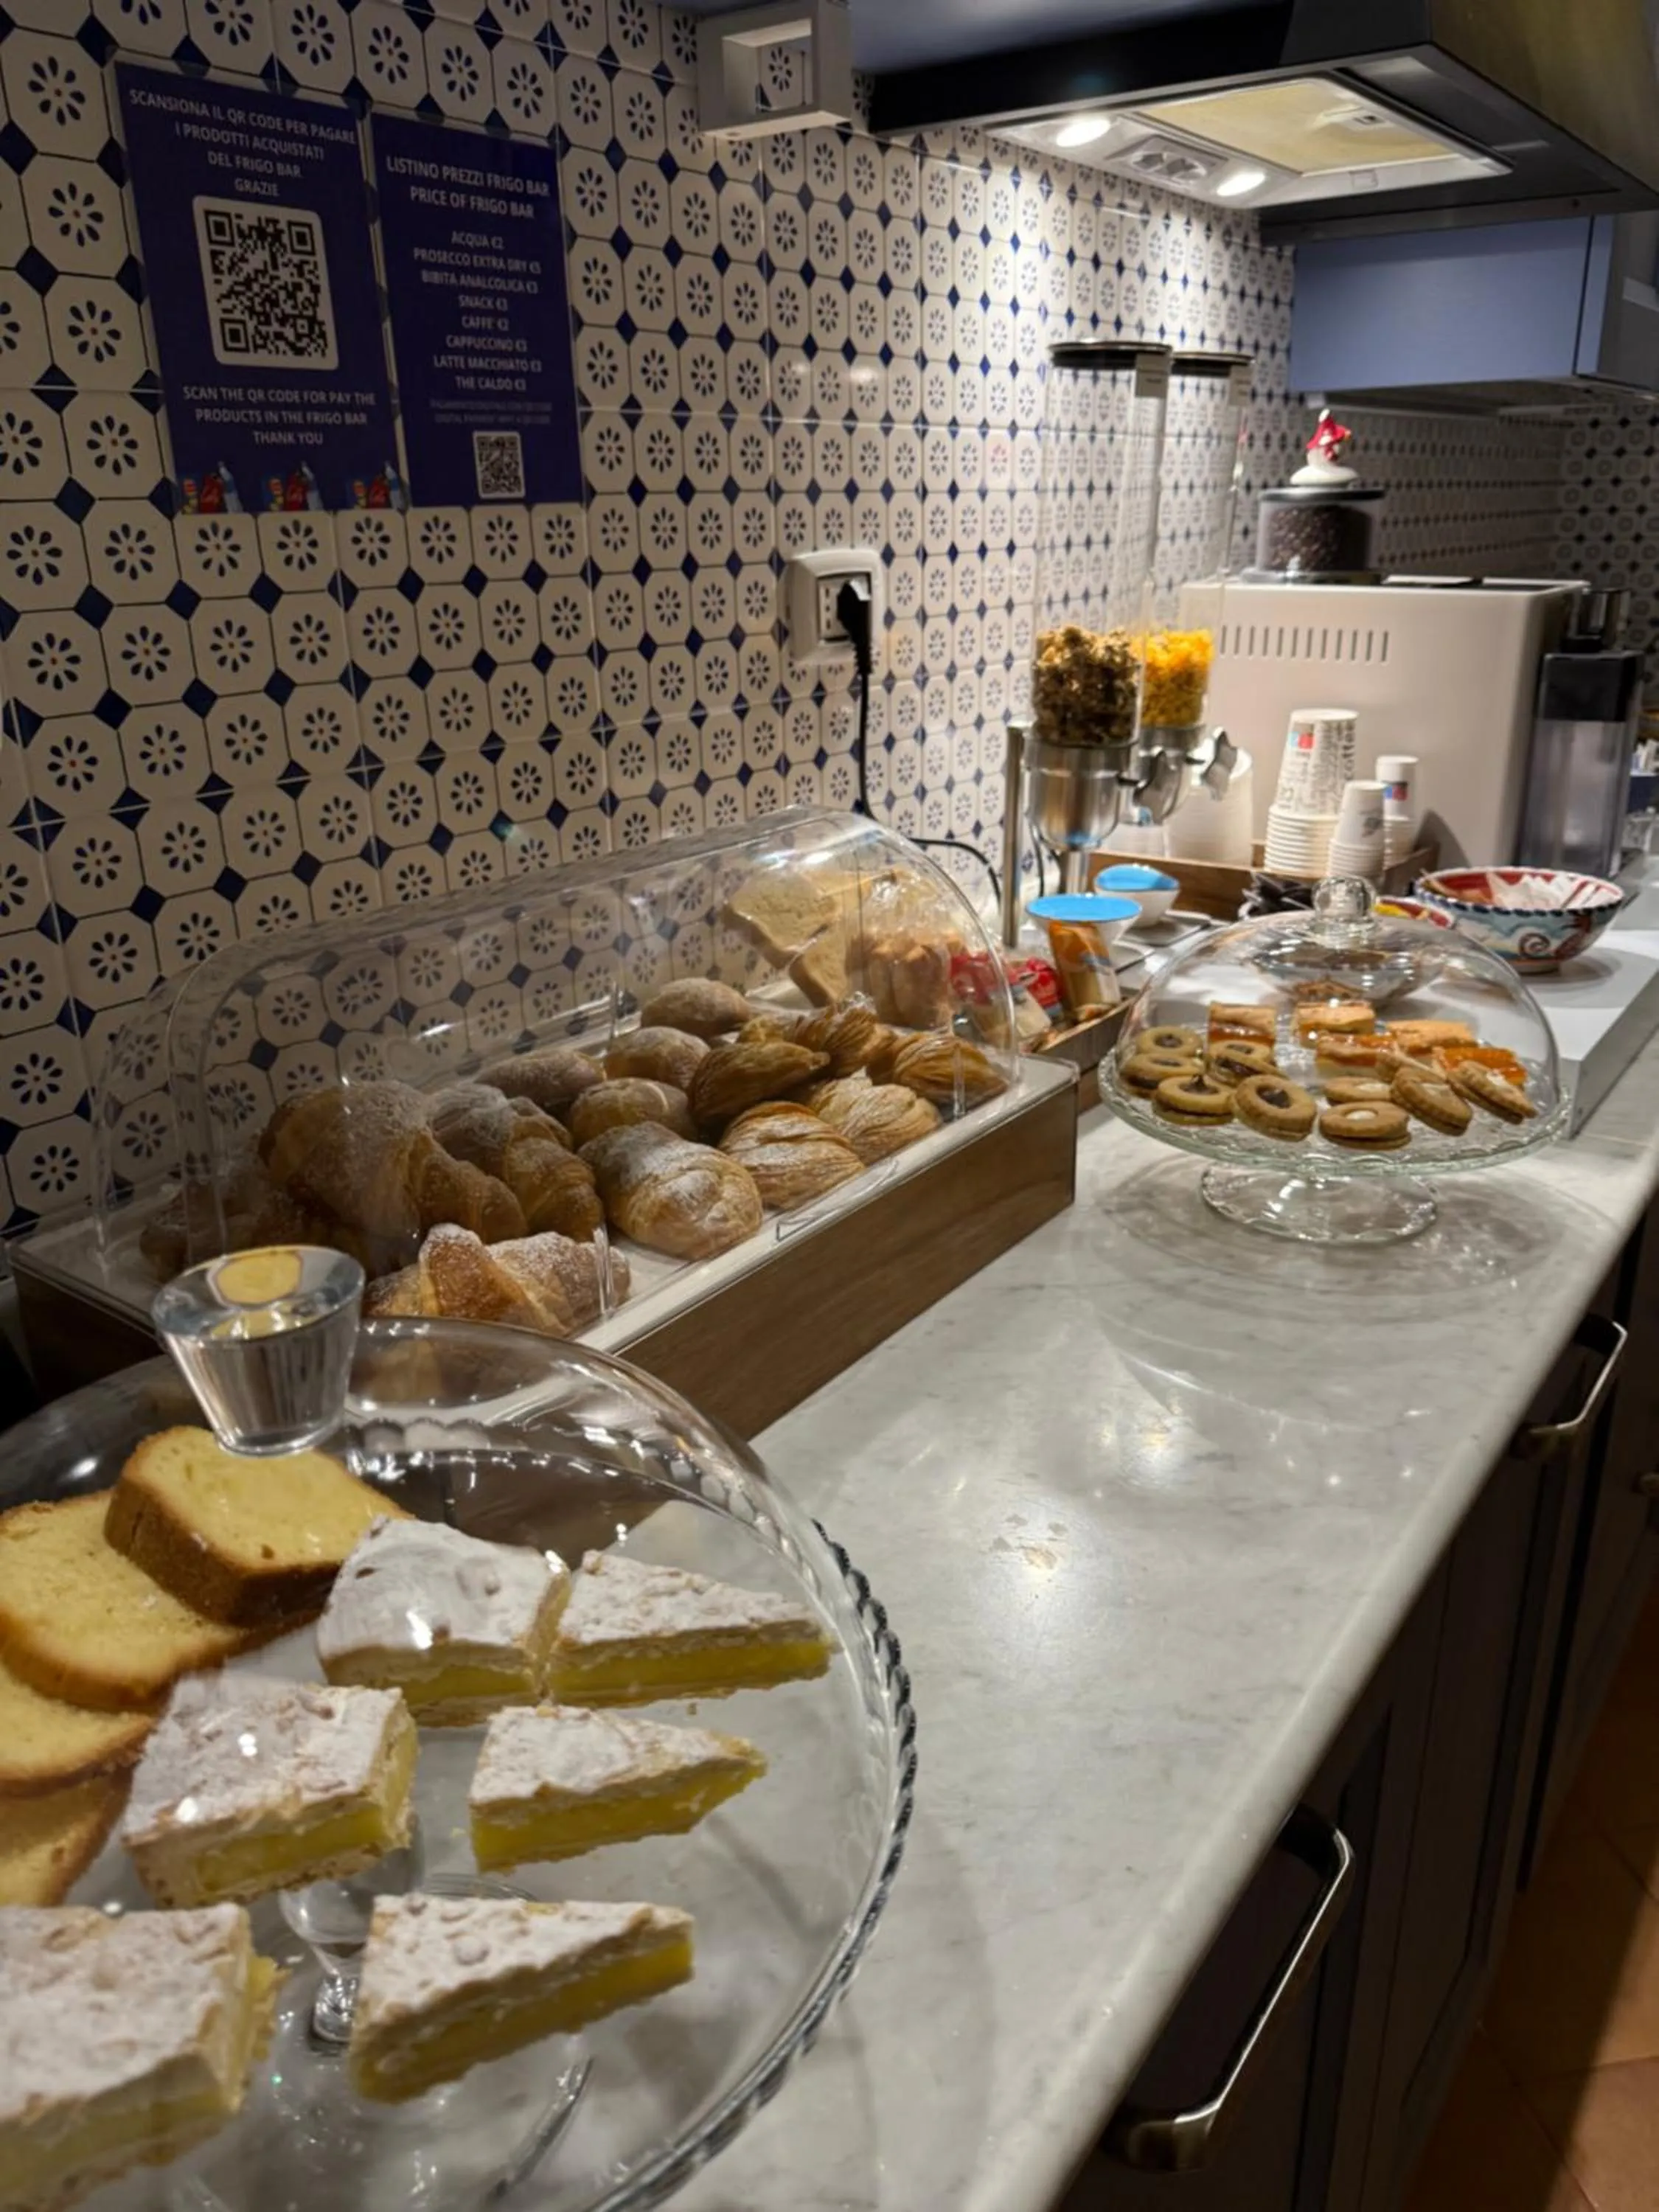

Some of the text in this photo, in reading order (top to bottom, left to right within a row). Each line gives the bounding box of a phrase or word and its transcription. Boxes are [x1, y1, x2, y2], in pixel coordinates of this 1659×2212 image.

[130, 89, 356, 144] SCANSIONA IL QR CODE PER PAGARE
[175, 122, 324, 160] I PRODOTTI ACQUISTATI
[208, 151, 302, 178] DEL FRIGO BAR
[386, 156, 550, 197] LISTINO PREZZI FRIGO BAR
[234, 178, 280, 197] GRAZIE
[410, 187, 535, 218] PRICE OF FRIGO BAR
[451, 231, 489, 248] ACQUA
[413, 247, 470, 266] PROSECCO
[473, 254, 505, 270] EXTRA
[422, 270, 457, 285] BIBITA
[459, 275, 524, 291] ANALCOLICA
[459, 295, 494, 310] SNACK
[434, 355, 465, 369] LATTE
[479, 377, 512, 391] CALDO
[183, 386, 376, 406] SCAN THE QR CODE FOR PAY THE
[195, 408, 367, 425] PRODUCTS IN THE FRIGO BAR
[254, 431, 324, 445] THANK YOU
